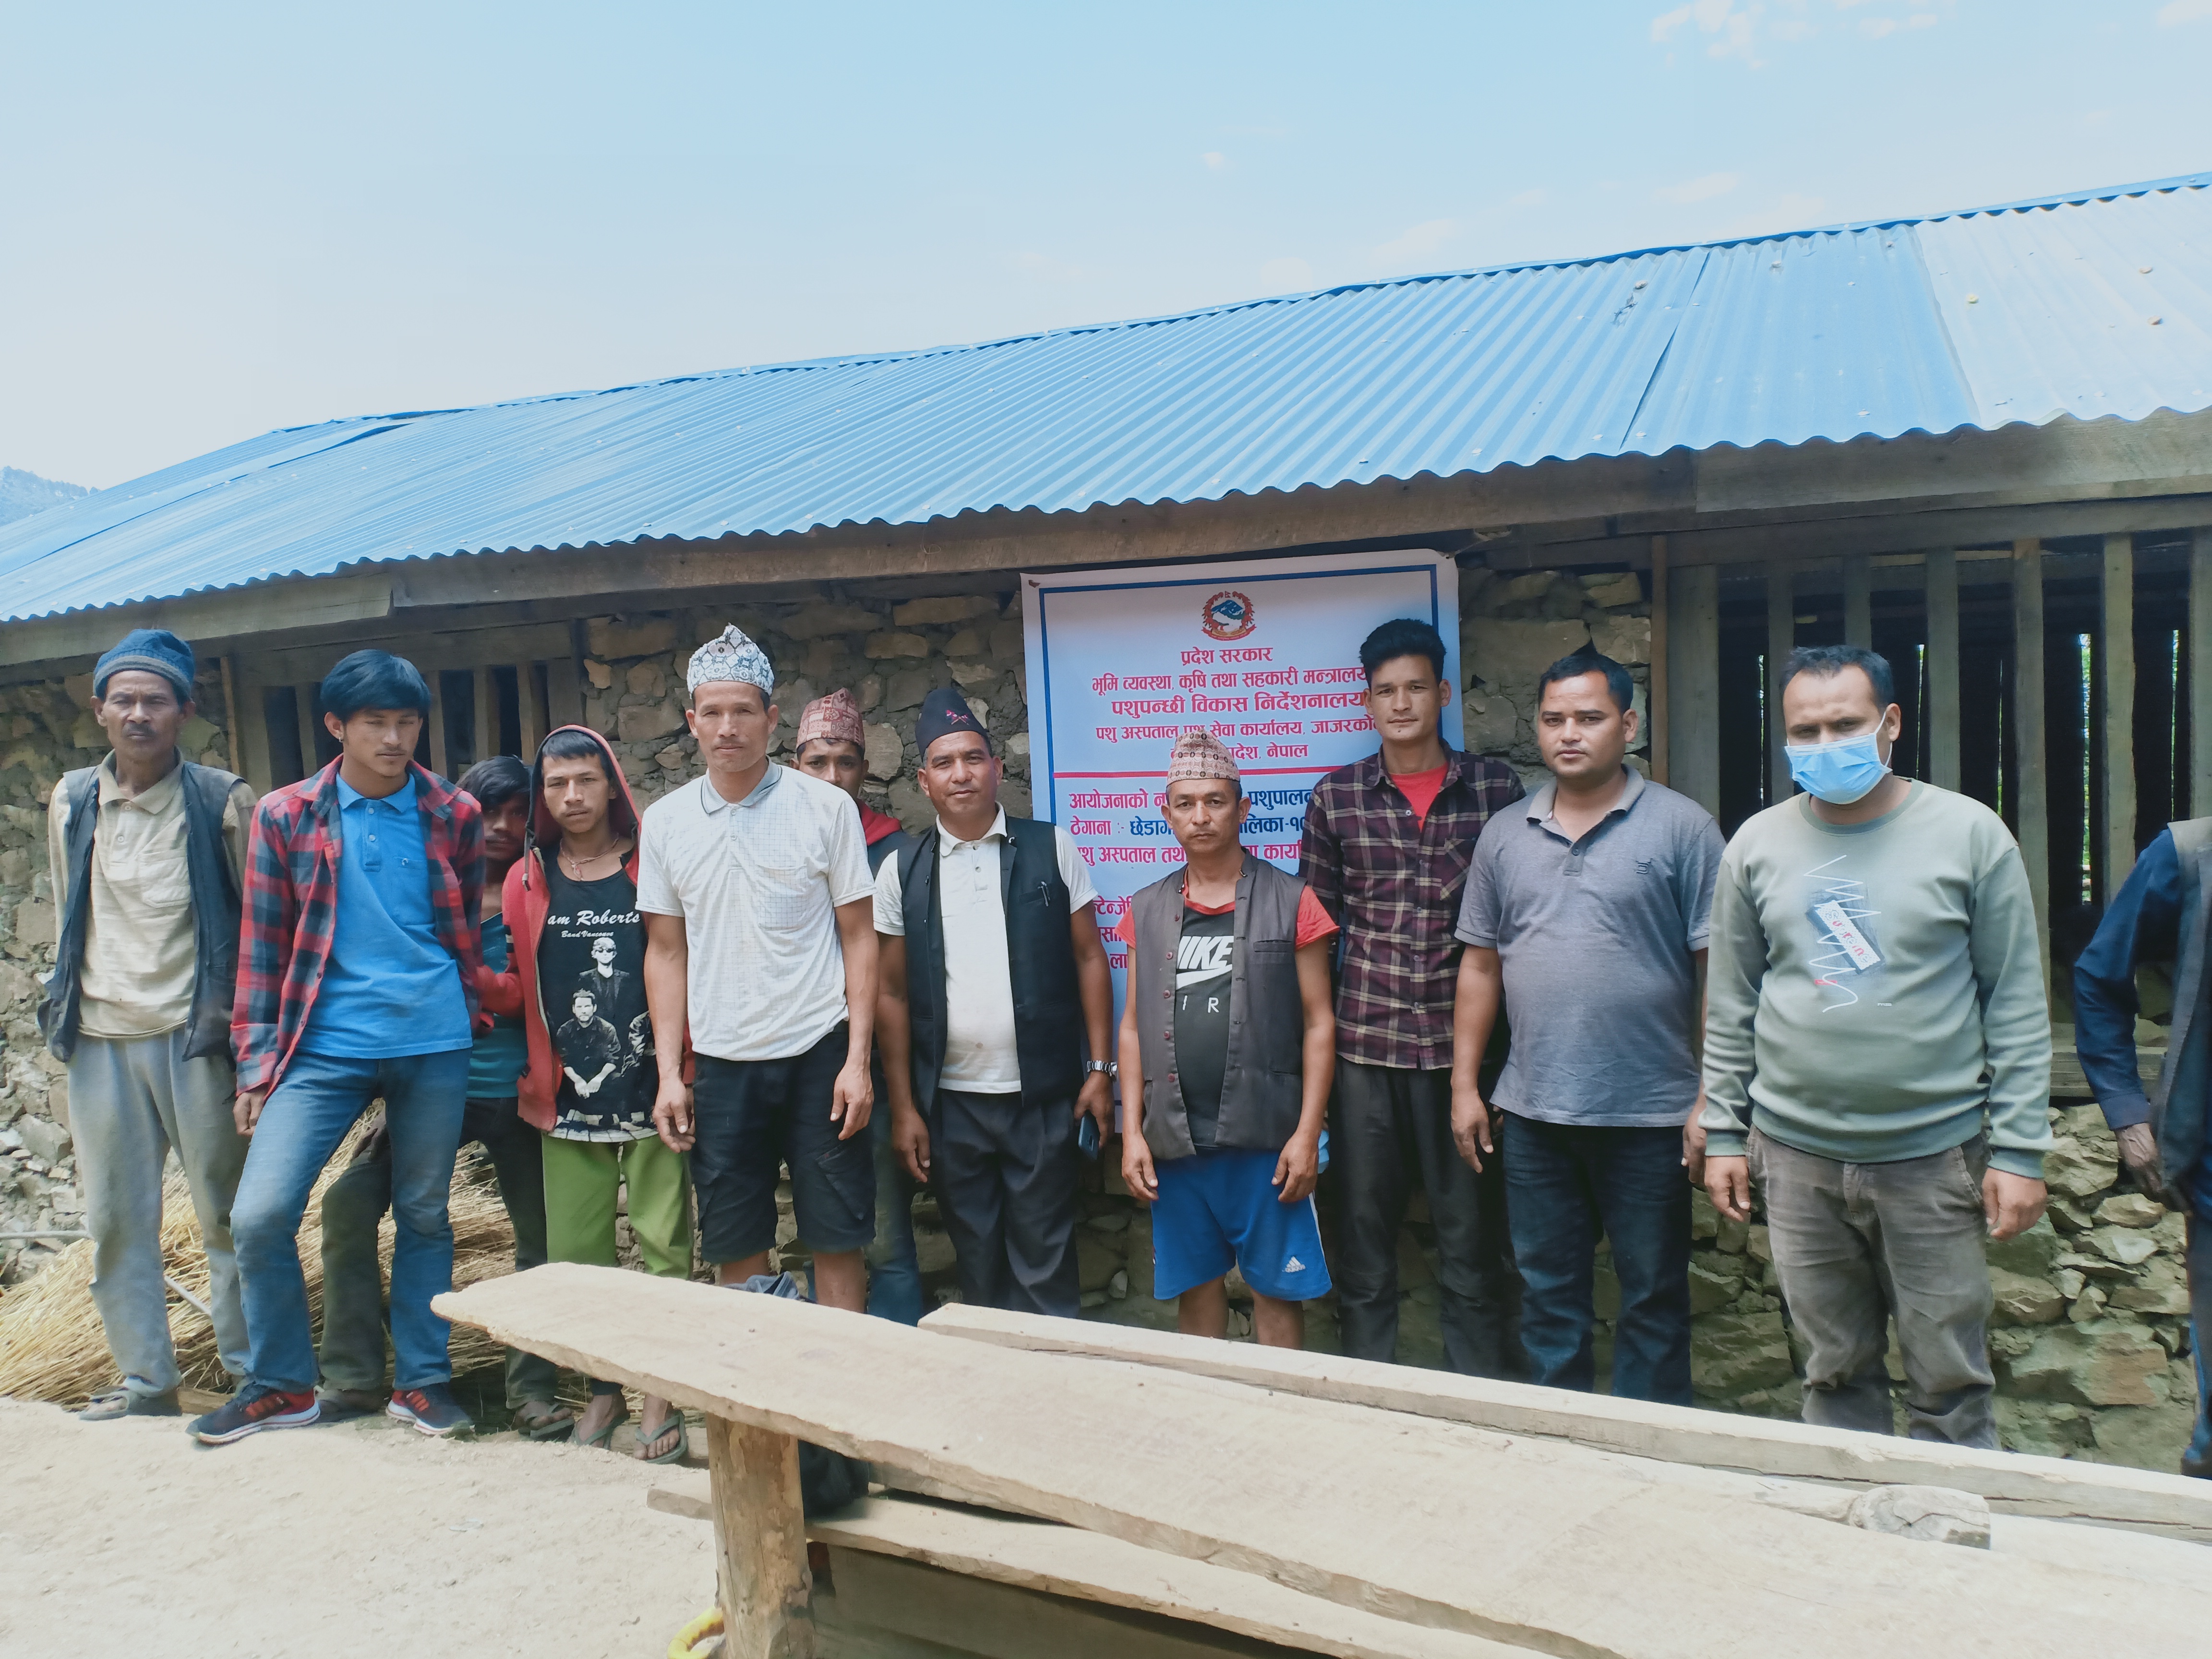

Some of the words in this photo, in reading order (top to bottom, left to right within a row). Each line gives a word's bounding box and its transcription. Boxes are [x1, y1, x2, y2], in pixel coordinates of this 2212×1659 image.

[1180, 647, 1214, 666] प्रदेश
[1219, 648, 1273, 663] सरकार
[1092, 673, 1119, 696] भूमि
[1179, 670, 1206, 693] कृषि
[1211, 673, 1237, 688] तथा
[1242, 666, 1298, 688] सहकारी
[1191, 694, 1249, 713] विकास
[1254, 691, 1364, 711] निर्देशनालय
[1096, 727, 1118, 743] पशु
[1121, 726, 1179, 739] अस्पताल
[1210, 720, 1236, 737] सेवा
[1310, 714, 1377, 733] जाजरको
[1267, 742, 1309, 757] नेपाल
[1069, 789, 1149, 808] आयोजनाको
[1070, 816, 1111, 835] ठेगाना
[1130, 816, 1175, 836] छेडाग
[1098, 847, 1156, 863] अस्पताल
[576, 909, 640, 926] Roberts
